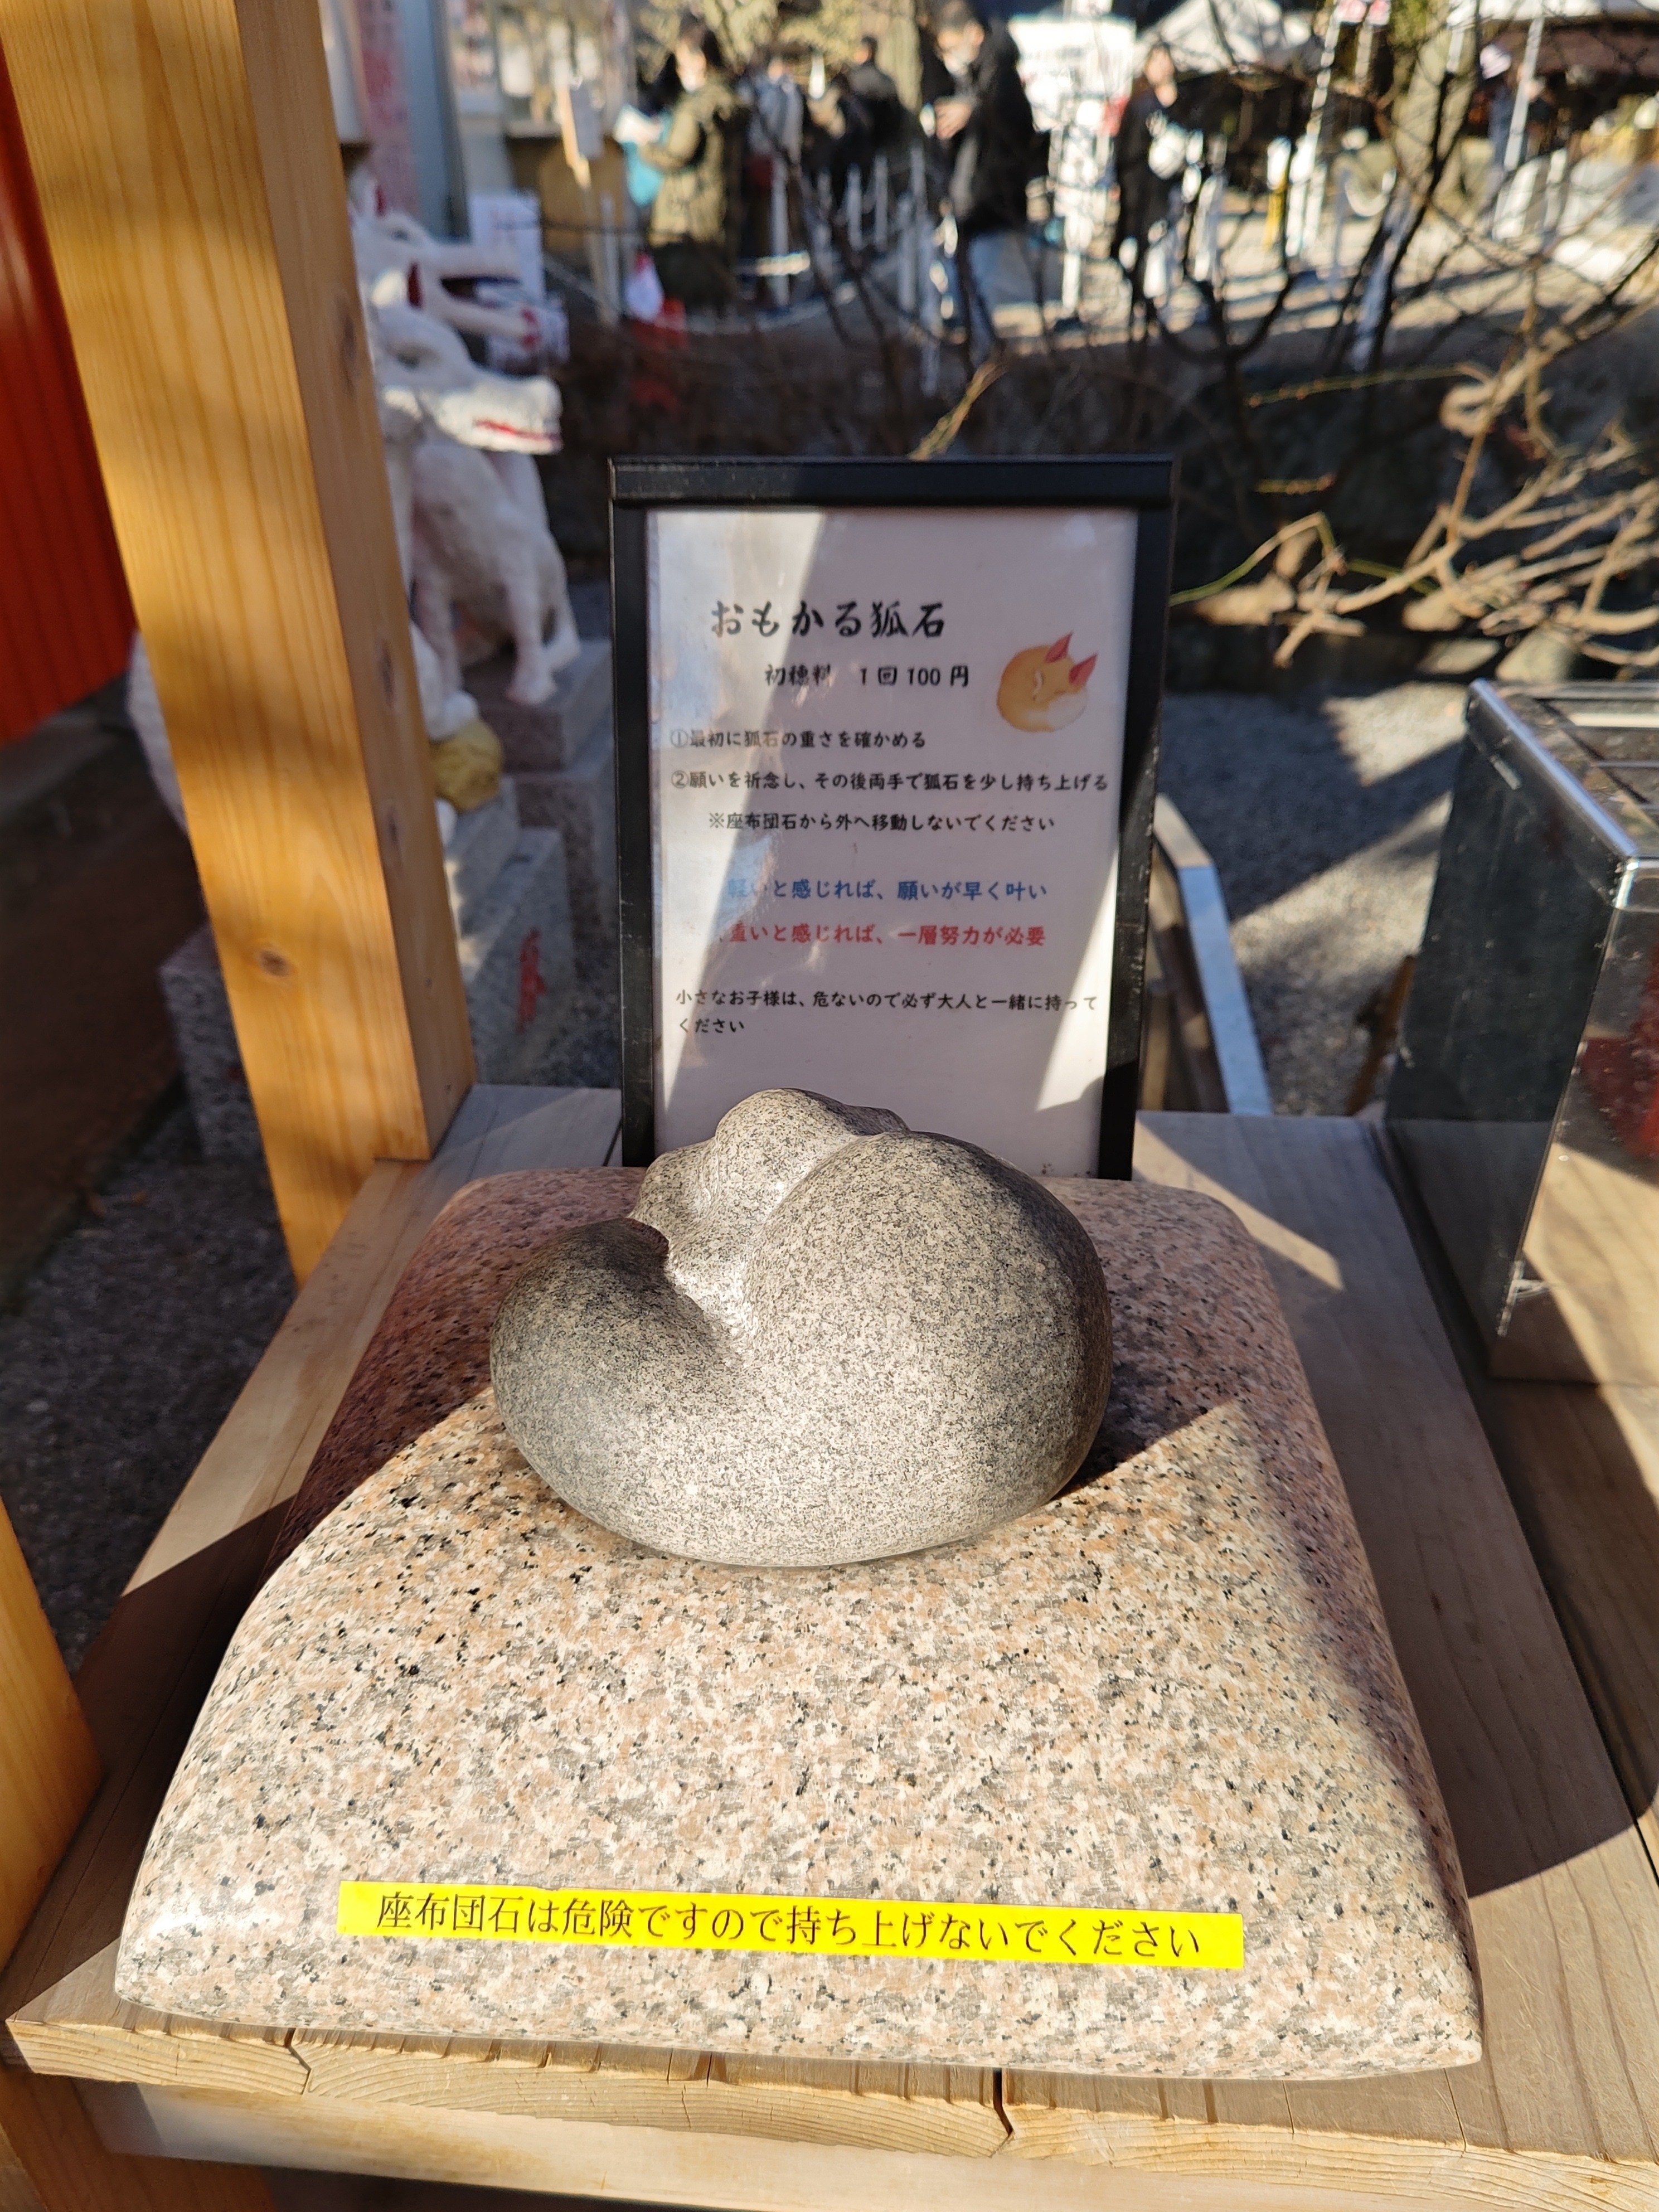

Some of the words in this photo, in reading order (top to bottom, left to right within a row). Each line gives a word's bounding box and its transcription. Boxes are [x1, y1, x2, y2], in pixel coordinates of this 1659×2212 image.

[711, 601, 945, 638] おもかる狐石
[670, 729, 926, 749] ①最初に狐石の重さを確かめる
[672, 770, 1108, 790] ②願いを祈念し、その後両手で狐石を少し持ち上げる
[709, 812, 1055, 832] ※座布団石から外へ移動しないでください
[729, 921, 1045, 946] 重いと感じれば、一層努力が必要
[676, 990, 1097, 1011] 小さなお子様は、危ないので必ず大人と一緒に持って
[678, 1017, 745, 1034] ください
[376, 1891, 1200, 1958] 座布団石は危険ですので持ち上げないでください
